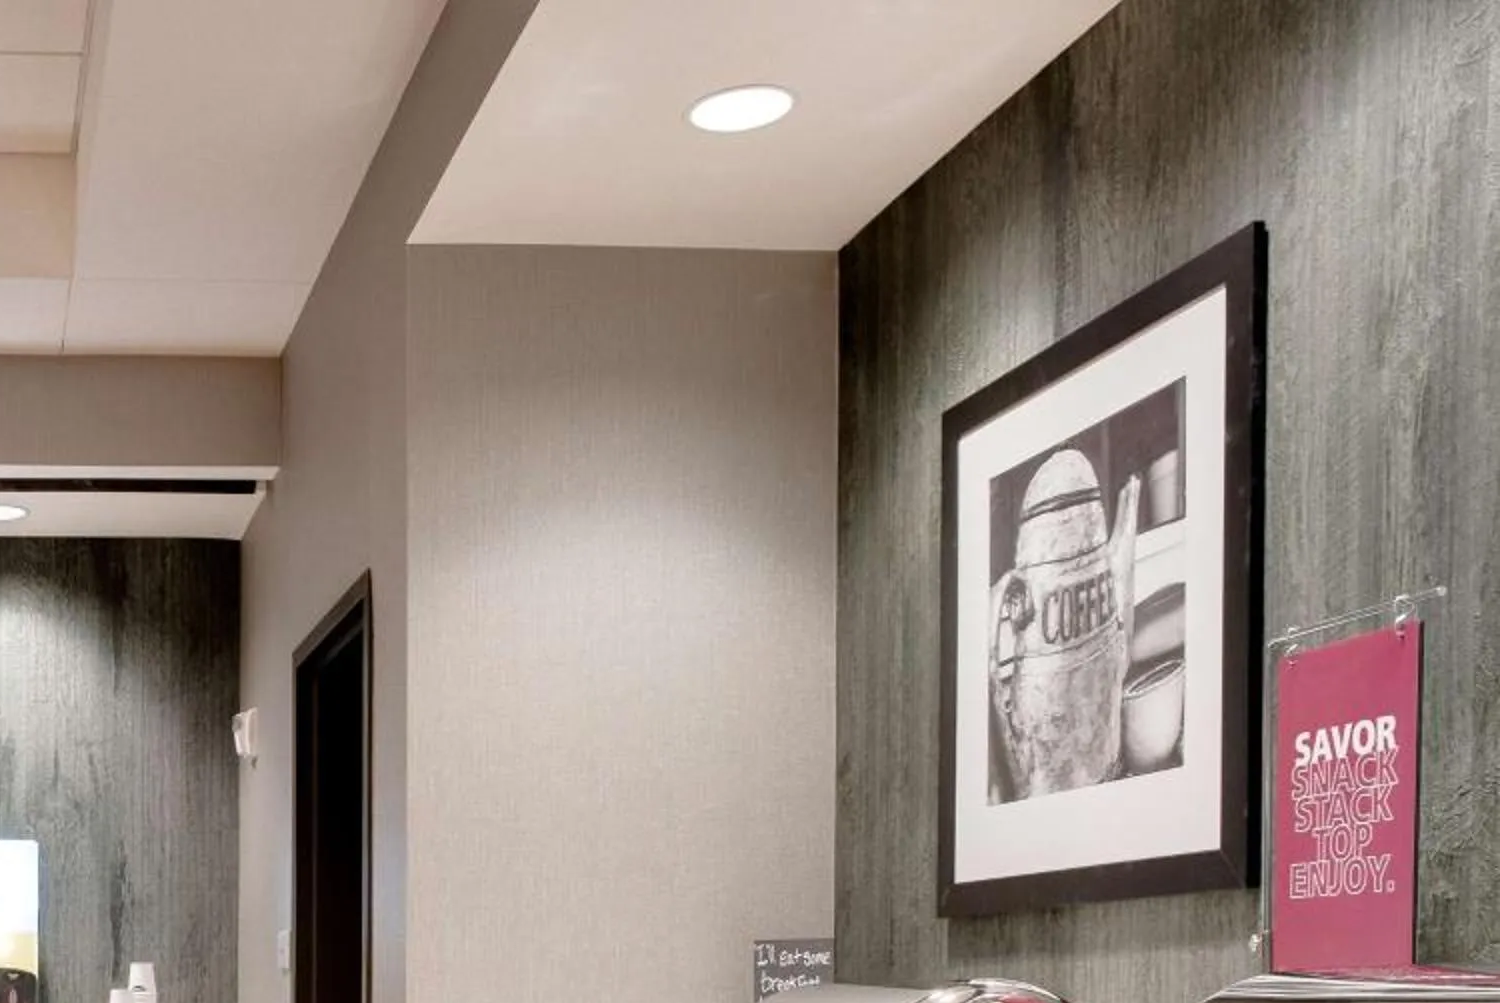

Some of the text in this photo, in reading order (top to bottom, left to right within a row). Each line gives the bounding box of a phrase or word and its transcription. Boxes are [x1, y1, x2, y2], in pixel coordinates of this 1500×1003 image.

[1294, 715, 1397, 768] SAVOR
[1291, 746, 1399, 800] SNACK
[1294, 784, 1394, 832] STACK
[1312, 823, 1373, 861] TOP
[1289, 853, 1395, 899] ENJOY.
